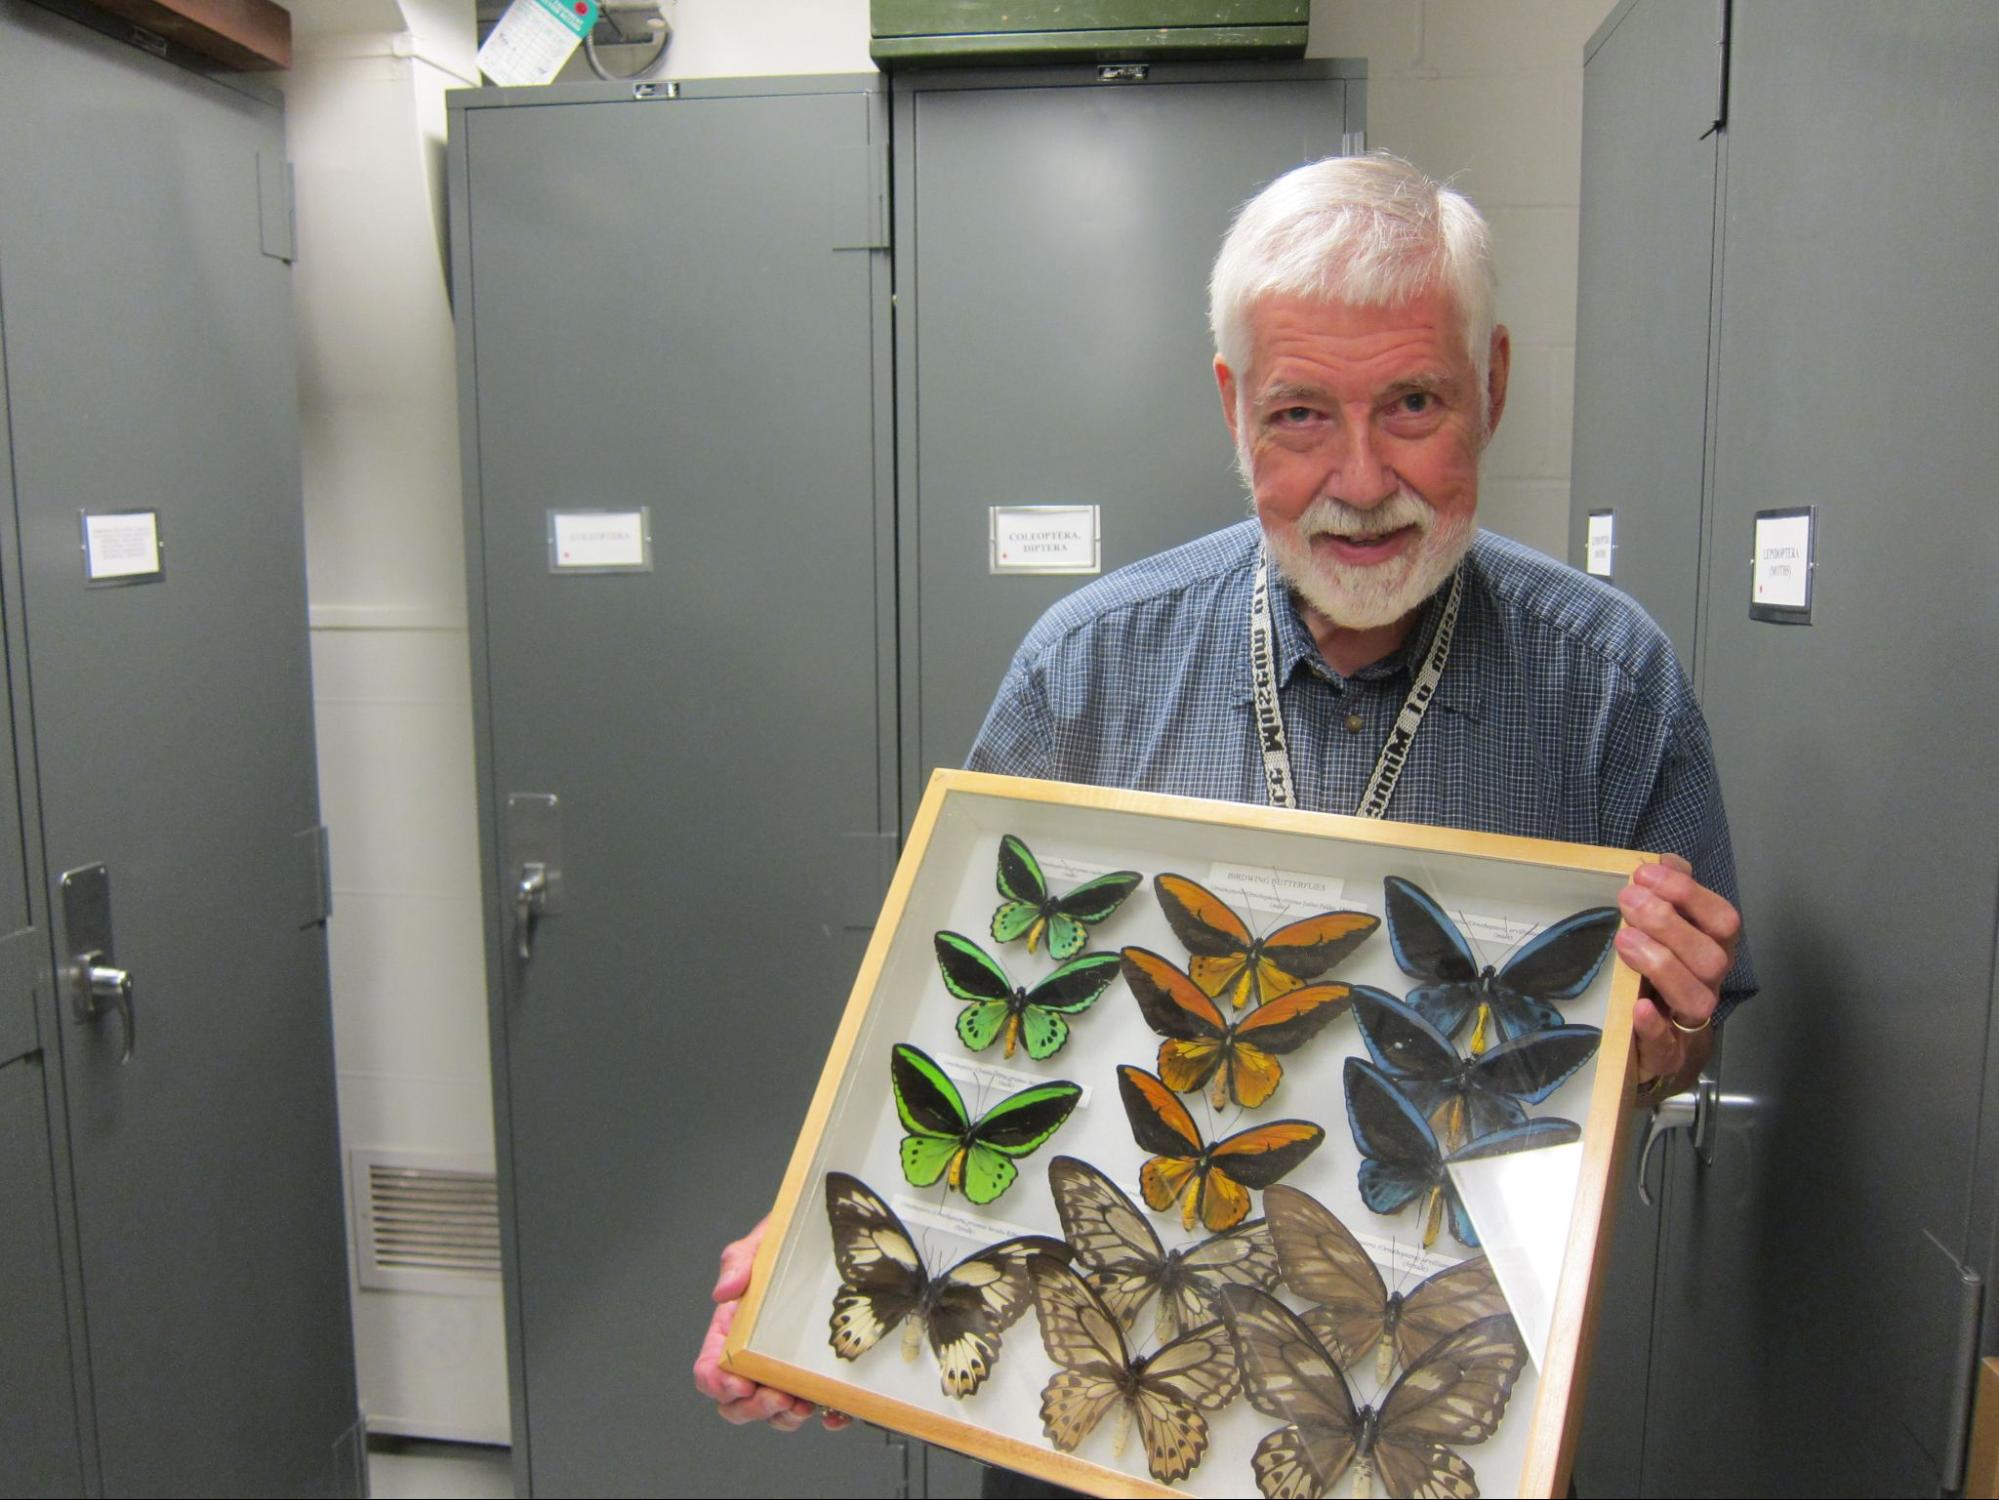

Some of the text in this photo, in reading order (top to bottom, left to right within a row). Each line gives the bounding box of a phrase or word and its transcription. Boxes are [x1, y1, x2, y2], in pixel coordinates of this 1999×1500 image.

[1023, 543, 1068, 552] DIPTERA
[1227, 871, 1326, 892] BIRDWING BUTTERFLIES
